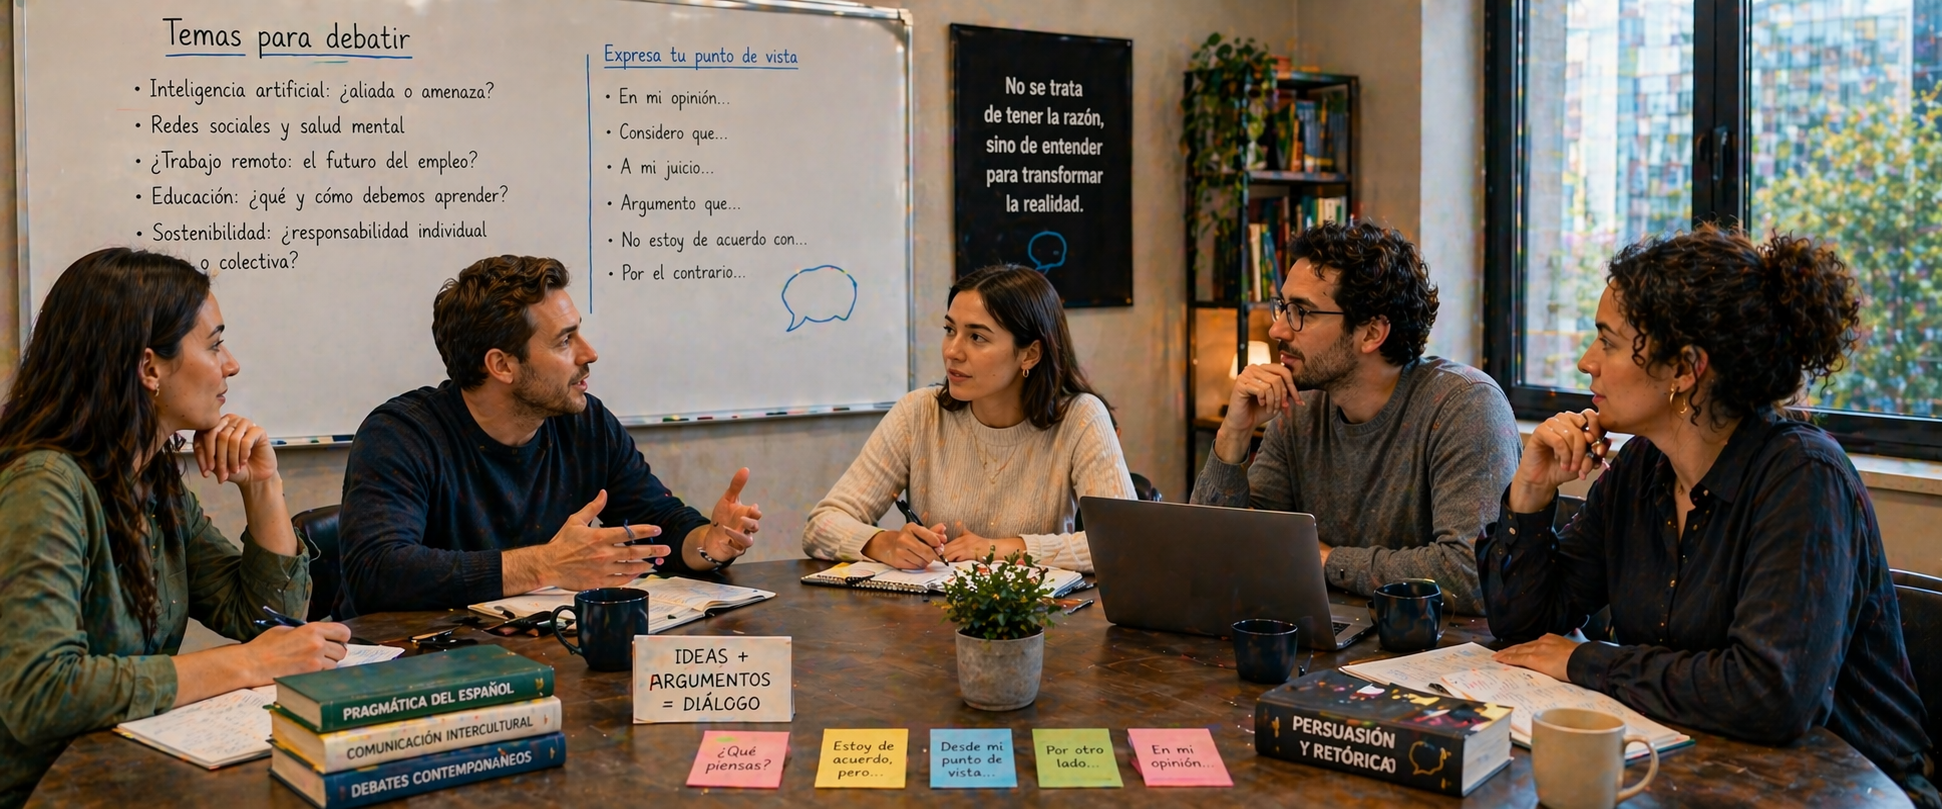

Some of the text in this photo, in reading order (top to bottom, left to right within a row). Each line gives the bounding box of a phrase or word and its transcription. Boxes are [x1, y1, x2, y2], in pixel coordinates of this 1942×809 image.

[162, 17, 411, 60] Temas para debatir
[604, 43, 799, 71] Expresa tu punto de vista
[149, 78, 495, 106] Inteligencia artificial: ¿aliada o amenaza?
[1005, 76, 1083, 97] No se trata
[619, 87, 731, 112] En mi opinión...
[984, 104, 1105, 129] de tener la razón,
[151, 114, 405, 142] Redes sociales y salud mental
[619, 122, 729, 146] Considero que...
[986, 134, 1104, 156] sino de entender
[150, 149, 478, 177] ¿Trabajo remoto: el futuro del empleo?
[620, 157, 715, 182] A mi juicio...
[986, 165, 1104, 188] para transformar
[152, 184, 509, 212] Educación: ¿qué y cómo debemos aprender?
[620, 193, 742, 218] Argumento que...
[1006, 193, 1084, 213] la realidad.
[152, 220, 487, 247] Sostenibilidad: ¿responsabilidad individual
[621, 229, 808, 253] No estoy de acuerdo con...
[199, 250, 299, 271] o colectiva?
[622, 263, 747, 281] Por el contrario...
[675, 647, 728, 665] IDEAS
[649, 671, 772, 692] ARGUMENTOS
[343, 696, 428, 721] PRAGMÁTICA
[431, 691, 455, 706] DEL
[683, 691, 761, 712] DIÁLOGO
[347, 716, 533, 760] COMUNICACIÓN INTERCULTURAL
[1293, 715, 1395, 749] PERSUASIÓN
[717, 745, 757, 759] ¿Qué
[833, 740, 894, 755] Estoy de
[941, 741, 1003, 752] Desde mi
[1046, 745, 1104, 755] Por otro
[1151, 744, 1194, 755] En mi
[1300, 740, 1311, 756] Y
[705, 758, 772, 775] piensas?
[832, 752, 893, 765] acuerdo,
[941, 753, 1002, 767] punto de
[1056, 757, 1100, 769] lado...
[1150, 756, 1215, 771] opinión...
[837, 769, 884, 780] pero...
[948, 767, 996, 778] vista...
[351, 775, 409, 798] DEBATES
